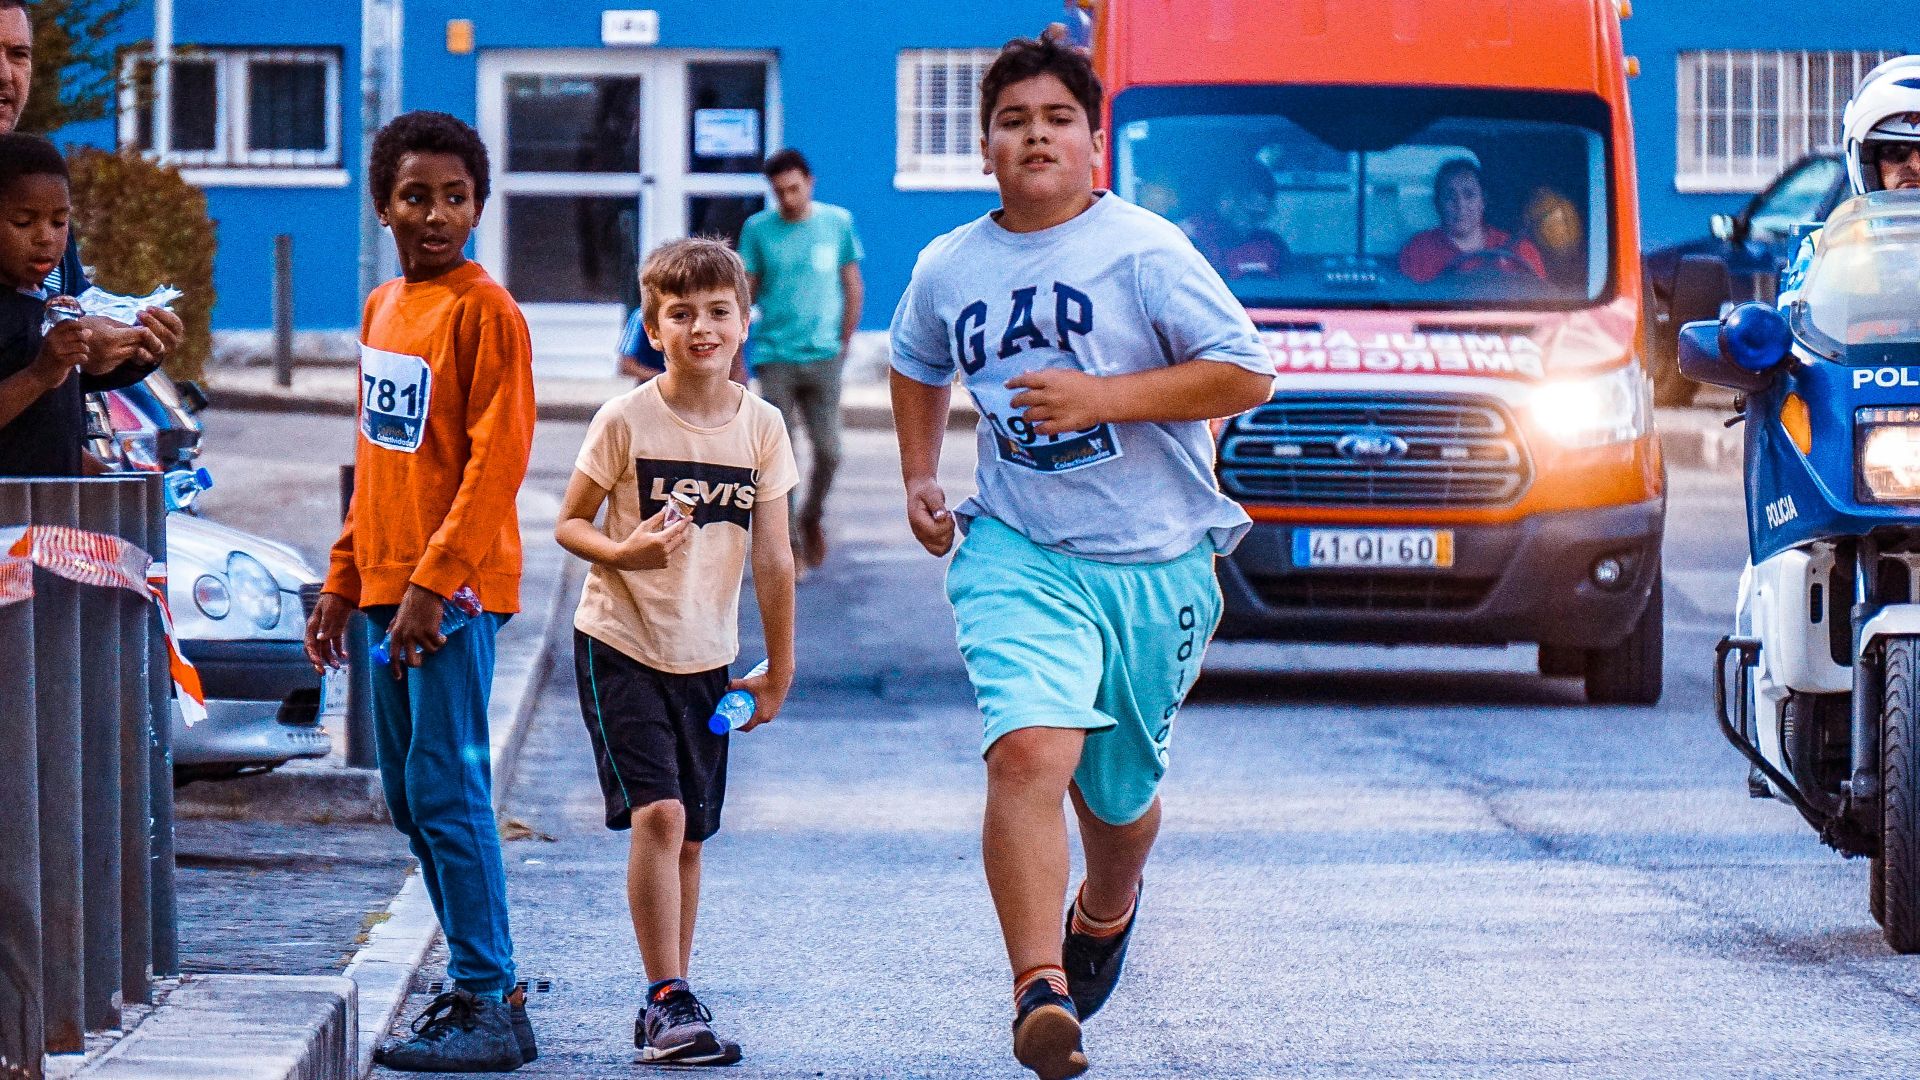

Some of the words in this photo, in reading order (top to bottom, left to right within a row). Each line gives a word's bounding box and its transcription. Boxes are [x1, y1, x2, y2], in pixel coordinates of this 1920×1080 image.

[955, 281, 1093, 376] GAP
[364, 373, 417, 417] 781
[1853, 367, 1920, 389] POL
[1766, 494, 1798, 530] POLICIA
